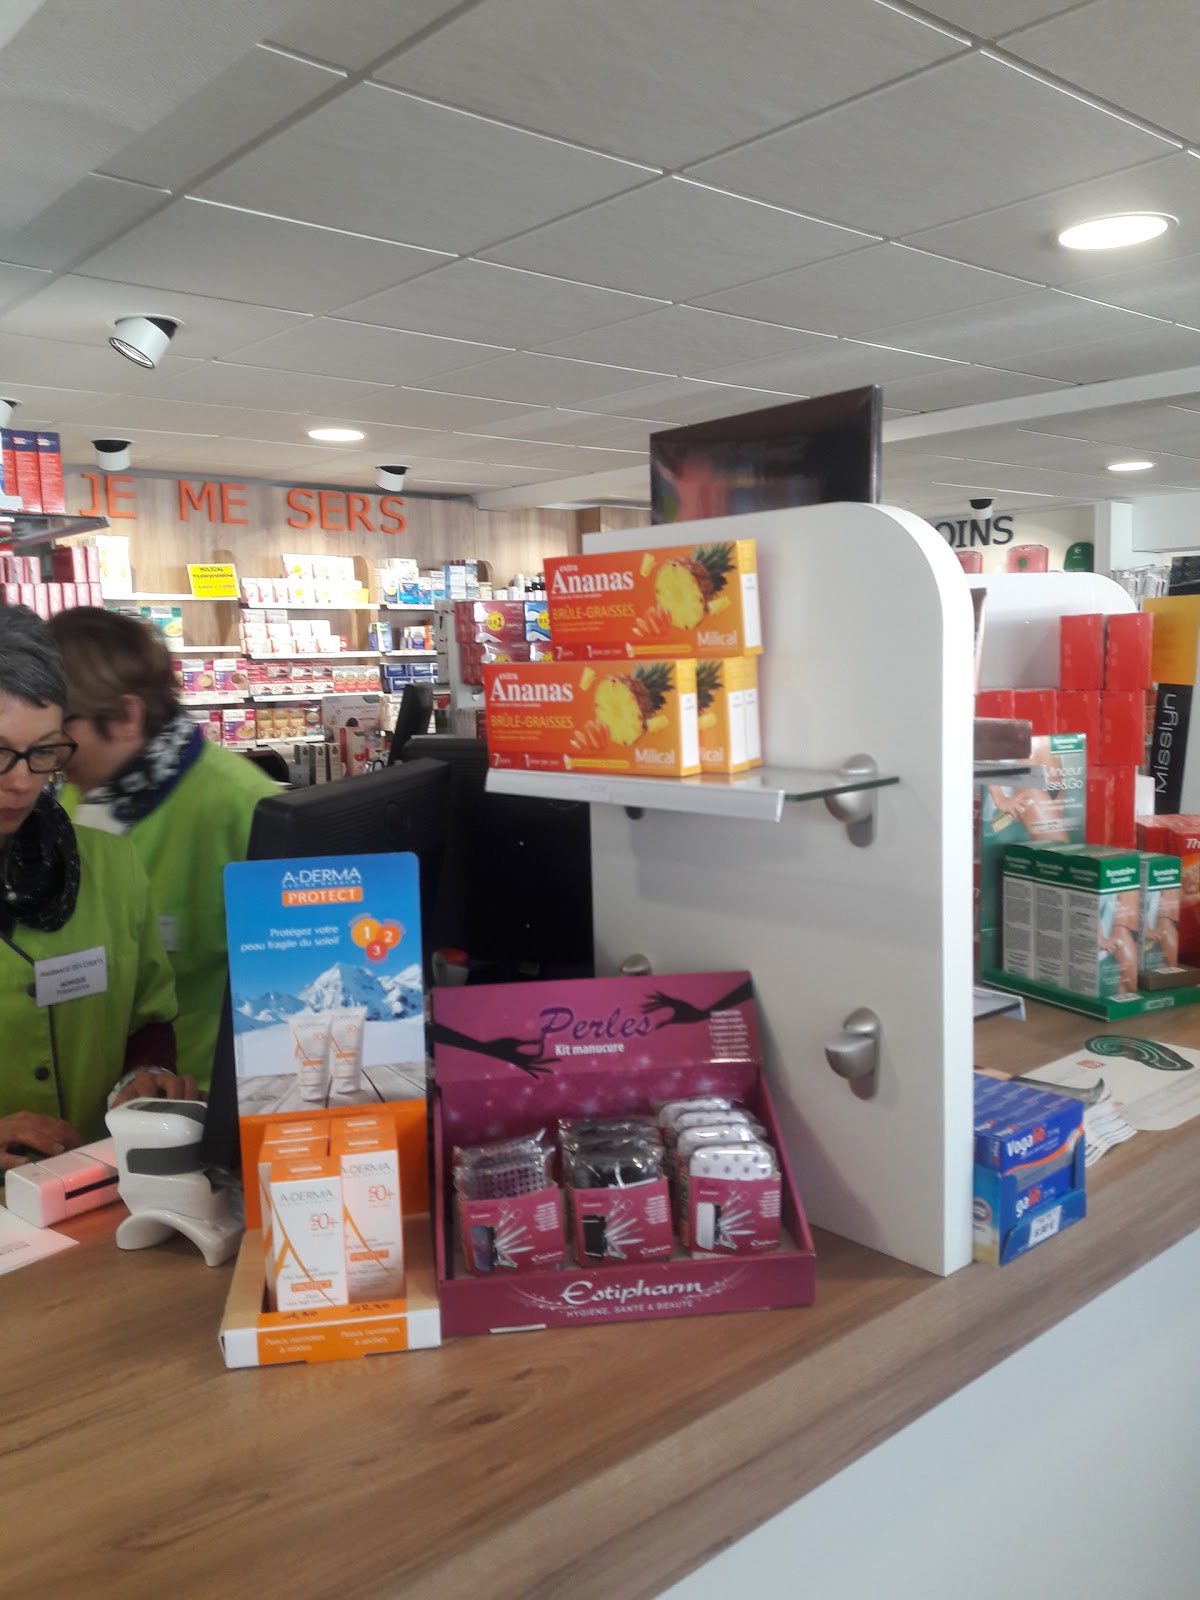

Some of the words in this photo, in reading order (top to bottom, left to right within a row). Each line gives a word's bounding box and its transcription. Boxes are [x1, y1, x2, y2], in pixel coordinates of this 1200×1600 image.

[79, 473, 137, 519] JE
[178, 479, 248, 524] ME
[287, 488, 407, 534] SERS
[551, 569, 634, 595] Ananas
[697, 630, 738, 646] Milical
[490, 678, 574, 702] Ananas
[1155, 692, 1179, 794] Misslyn
[635, 748, 676, 764] Milical
[281, 867, 361, 884] A-DERMA
[288, 888, 356, 904] PROTECT
[315, 925, 339, 934] votre
[363, 926, 371, 940] 1
[384, 931, 393, 943] 2
[300, 939, 312, 947] du
[372, 944, 381, 956] 3
[539, 1007, 651, 1041] Perles
[555, 1043, 571, 1056] Kit
[572, 1043, 625, 1056] manucure
